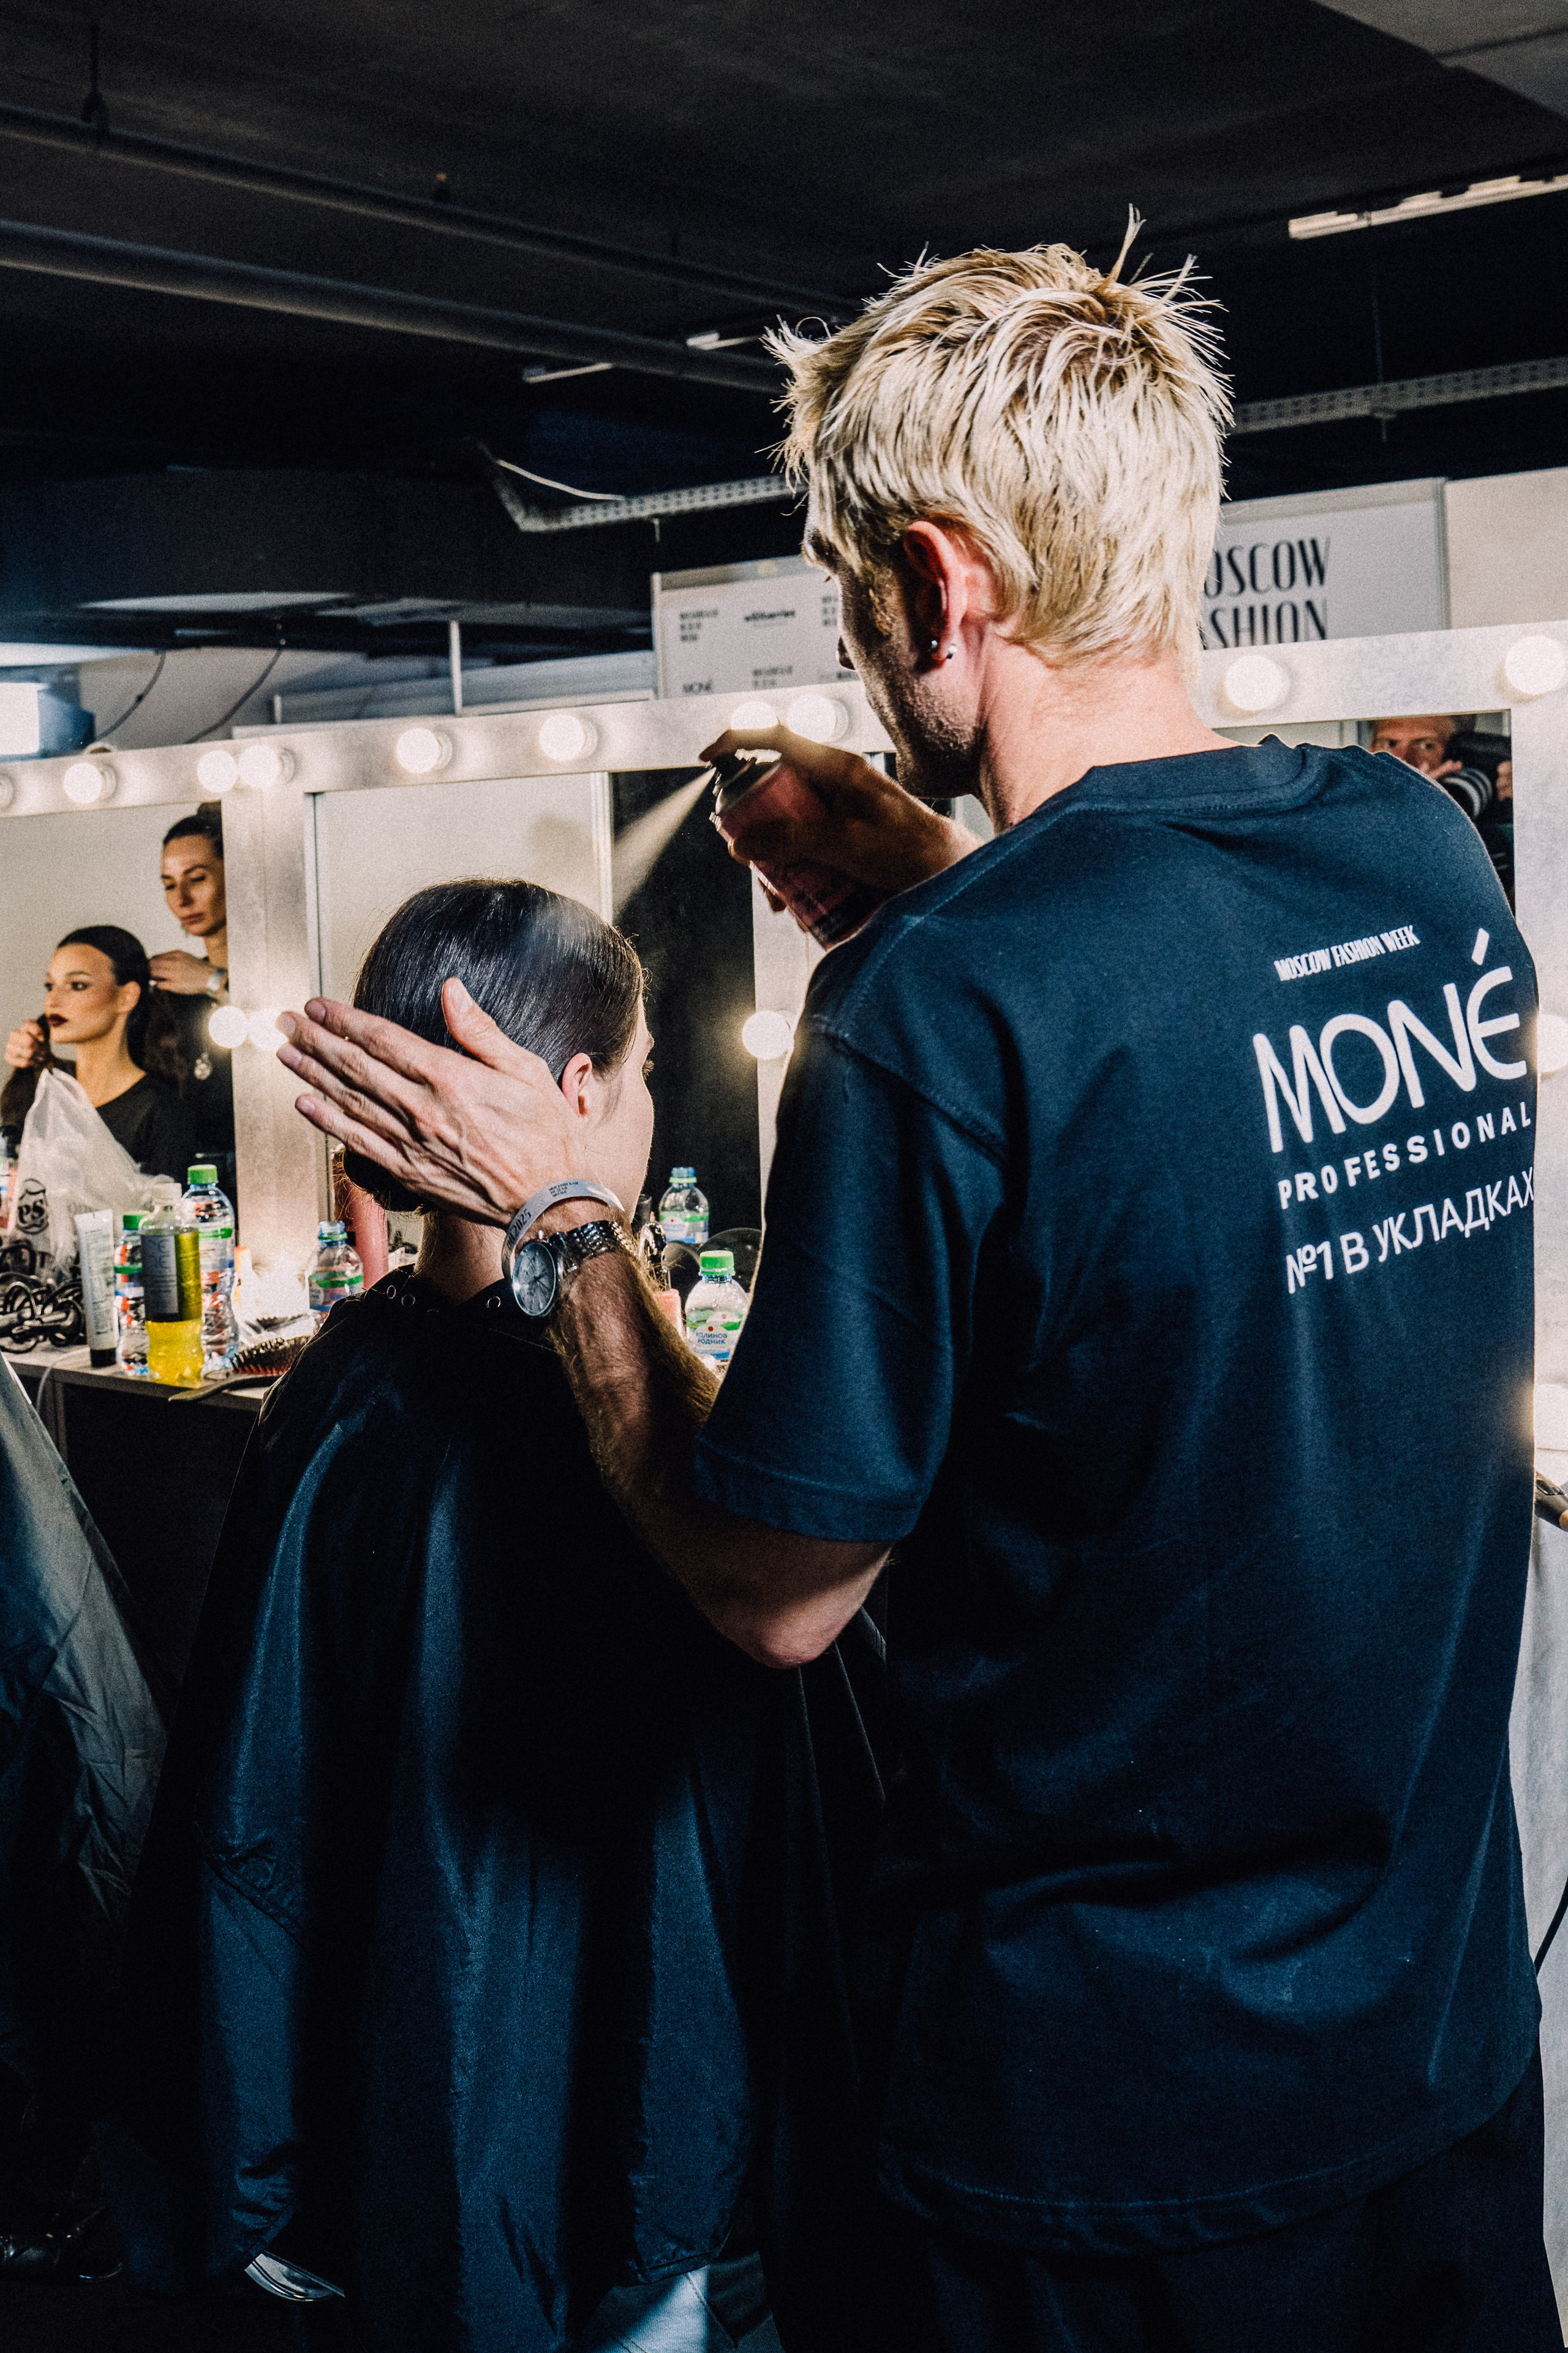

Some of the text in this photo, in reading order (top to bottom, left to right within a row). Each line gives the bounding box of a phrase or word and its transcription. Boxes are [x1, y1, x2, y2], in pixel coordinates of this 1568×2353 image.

[1204, 536, 1331, 599] OSCOW
[1210, 599, 1327, 648] SHION
[1274, 924, 1420, 981] MOSCOW FASHION WEEK
[1253, 927, 1528, 1153] MONÉ
[1278, 1101, 1531, 1209] PROFESSIONAL
[1340, 1231, 1369, 1274] В
[1372, 1166, 1534, 1263] УКЛАДКАХ
